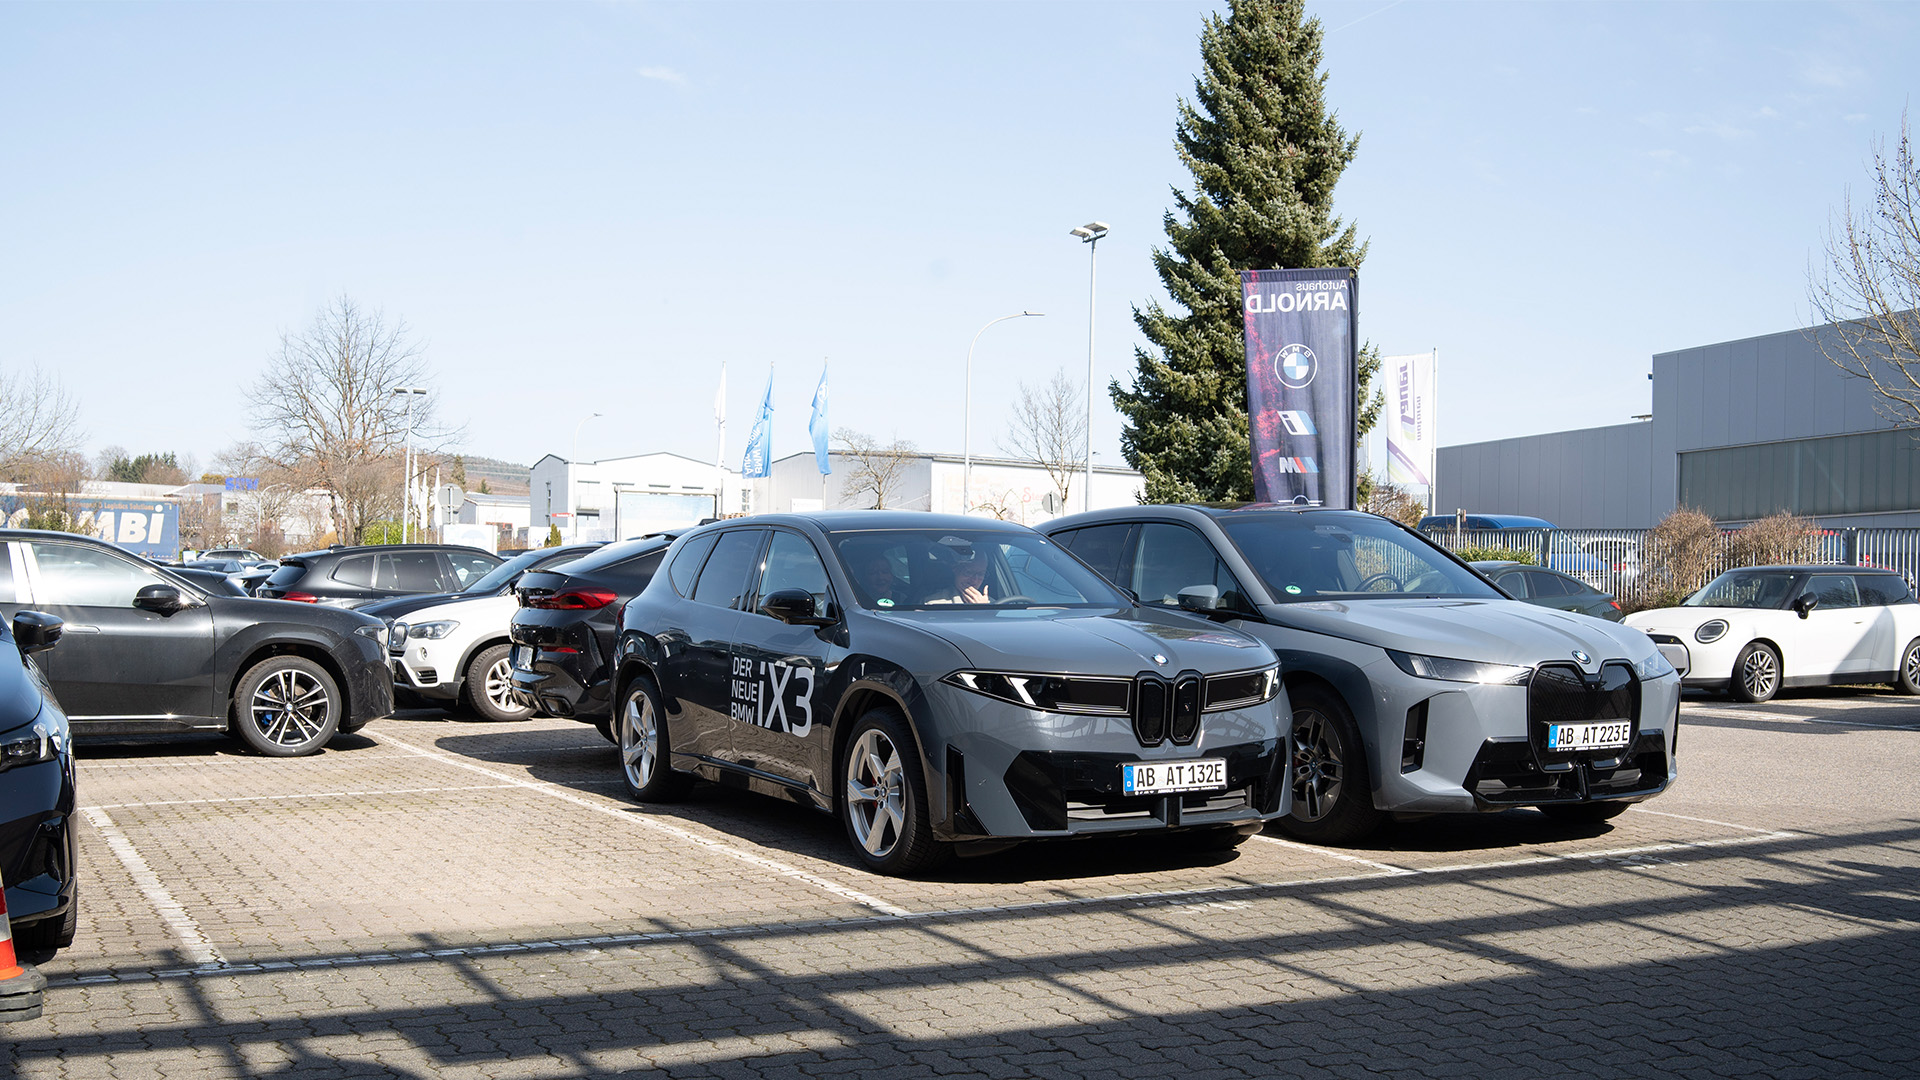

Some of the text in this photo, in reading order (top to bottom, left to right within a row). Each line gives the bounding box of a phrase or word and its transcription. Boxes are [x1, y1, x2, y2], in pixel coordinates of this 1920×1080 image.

[104, 502, 128, 511] Logistics
[129, 503, 154, 511] Solutions
[733, 656, 753, 678] DER
[731, 679, 758, 702] NEUE
[757, 660, 815, 738] iX3
[731, 702, 755, 724] BMW
[1558, 727, 1574, 745] AB
[1582, 726, 1598, 744] AT
[1136, 767, 1155, 787] AB
[1166, 765, 1184, 786] AT
